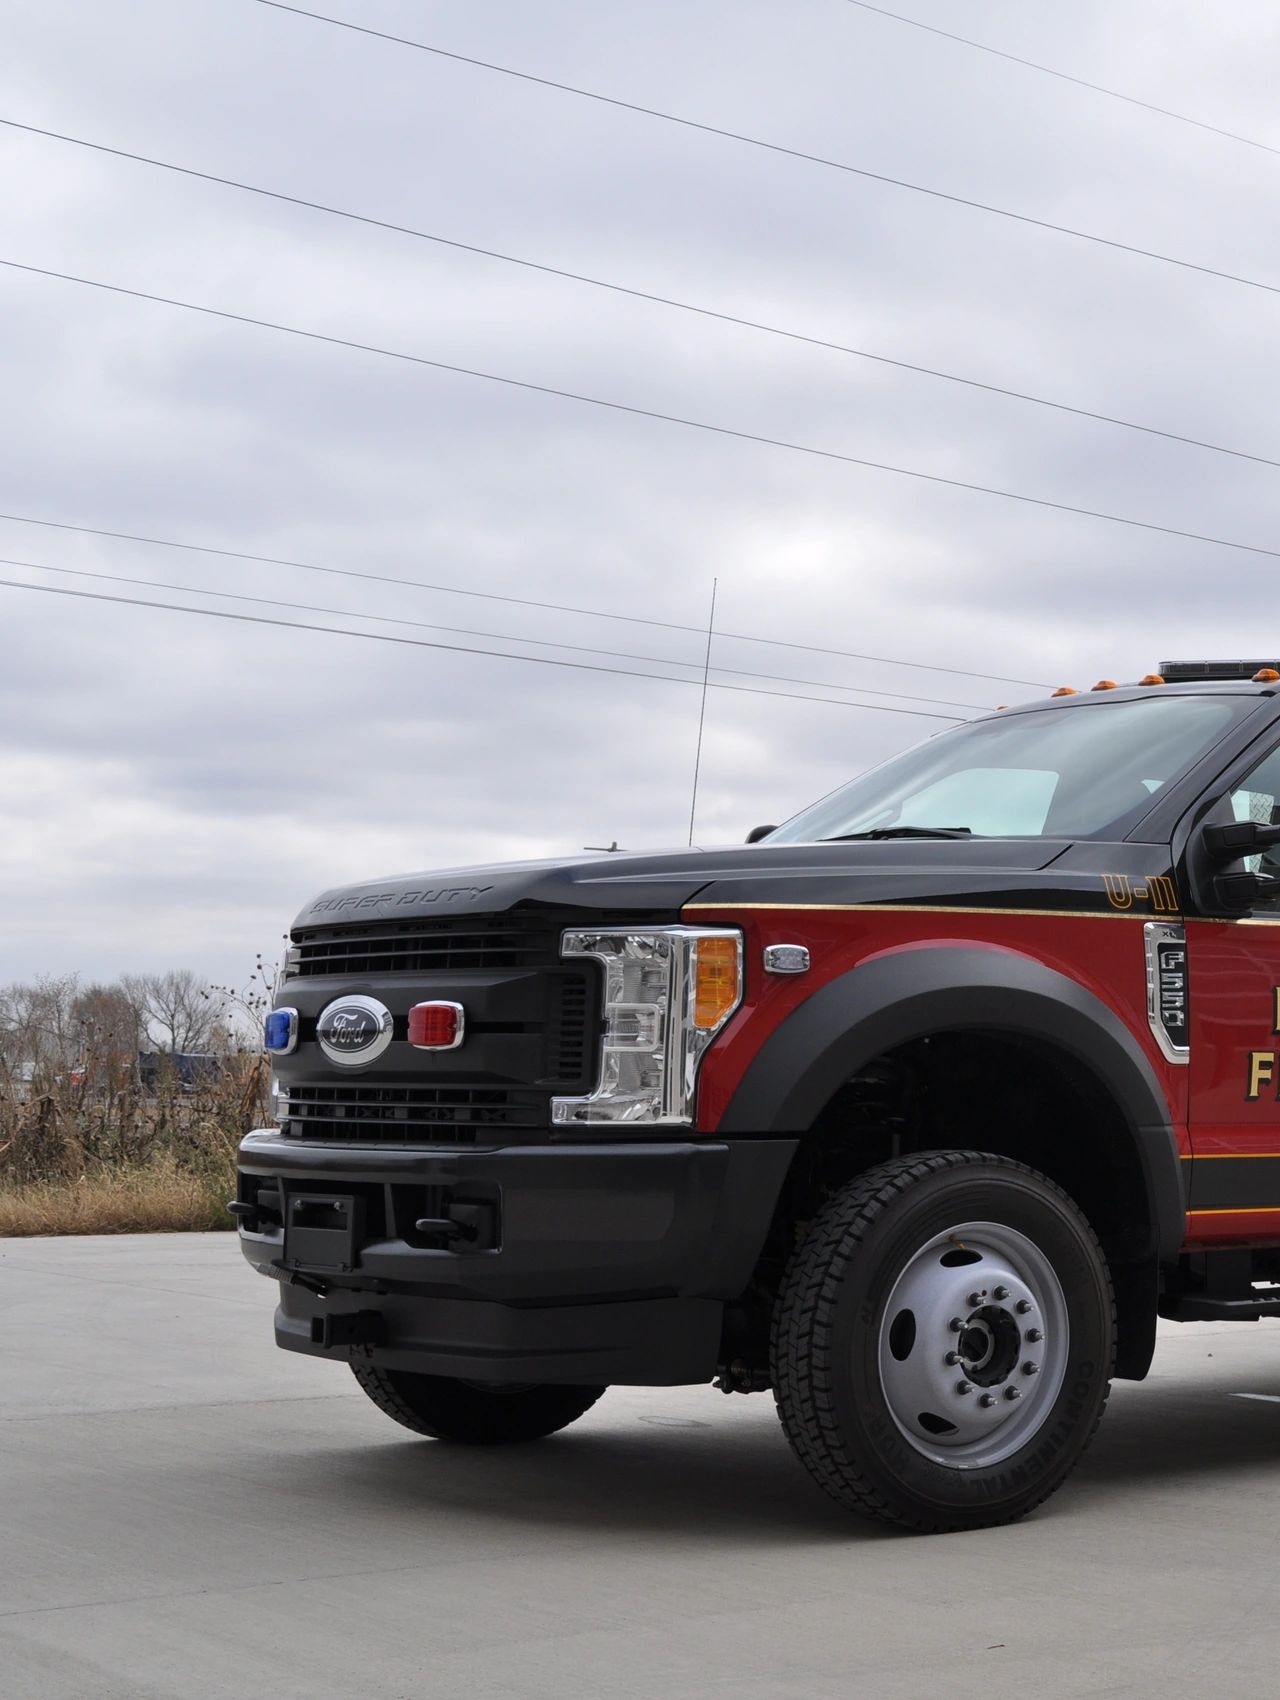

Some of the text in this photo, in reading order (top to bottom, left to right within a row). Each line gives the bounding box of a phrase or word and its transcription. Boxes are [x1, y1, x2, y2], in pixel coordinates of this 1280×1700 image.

[310, 885, 494, 914] SUPER DUTY
[1104, 874, 1179, 911] U-11
[329, 1013, 367, 1044] Ford
